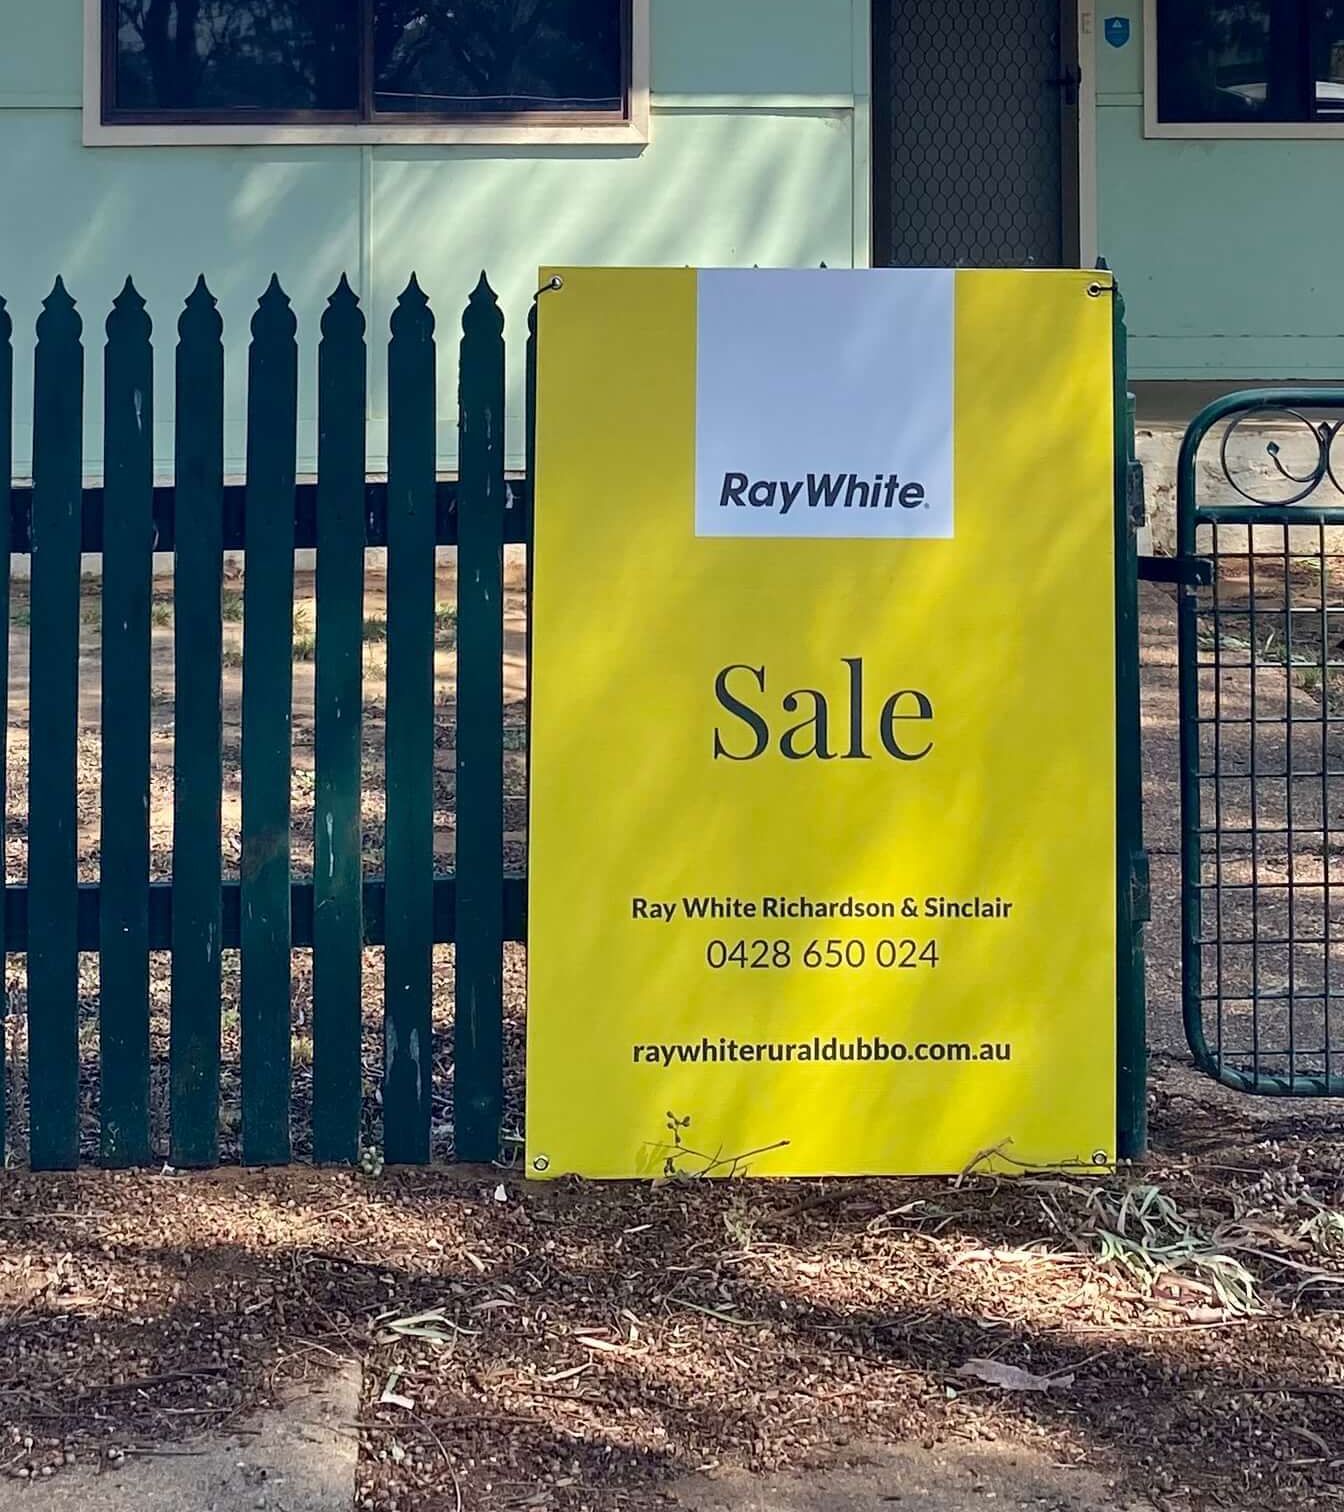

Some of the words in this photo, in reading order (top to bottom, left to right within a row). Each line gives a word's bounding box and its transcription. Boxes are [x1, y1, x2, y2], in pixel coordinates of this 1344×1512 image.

[713, 657, 934, 761] Sale
[632, 897, 677, 923] Ray
[681, 896, 757, 918] White
[762, 895, 895, 919] Richardson
[900, 897, 919, 918] &
[924, 896, 1013, 919] Sinclair
[706, 939, 791, 969] 0428
[803, 939, 866, 969] 650
[876, 939, 940, 969] 024
[633, 1036, 1011, 1068] raywhiteruraldubbo.com.au
